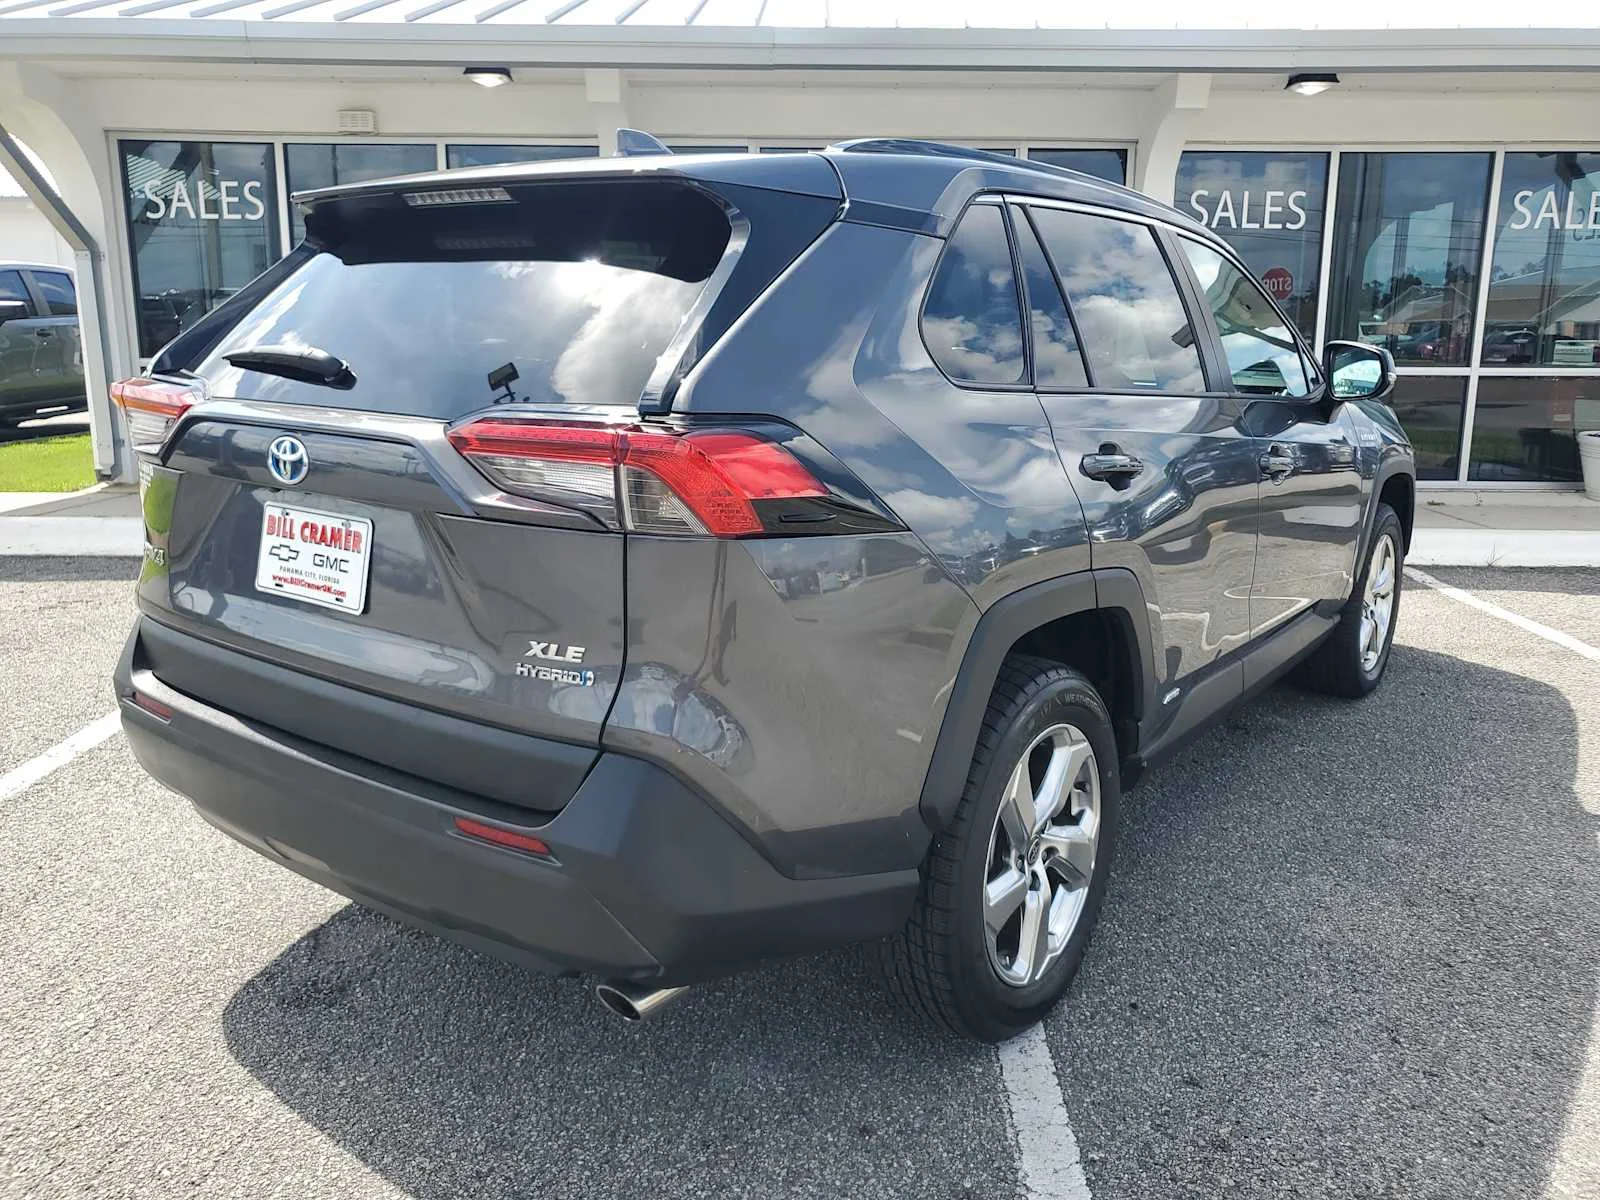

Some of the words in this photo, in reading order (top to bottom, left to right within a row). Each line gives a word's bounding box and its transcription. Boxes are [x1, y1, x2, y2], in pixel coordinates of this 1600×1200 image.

[144, 179, 265, 221] SALES
[1190, 189, 1307, 230] SALES
[266, 514, 295, 539] BILL
[300, 521, 363, 554] CRAMER
[313, 553, 349, 573] GMC
[525, 641, 585, 663] XLE
[515, 662, 582, 685] HYBRID
